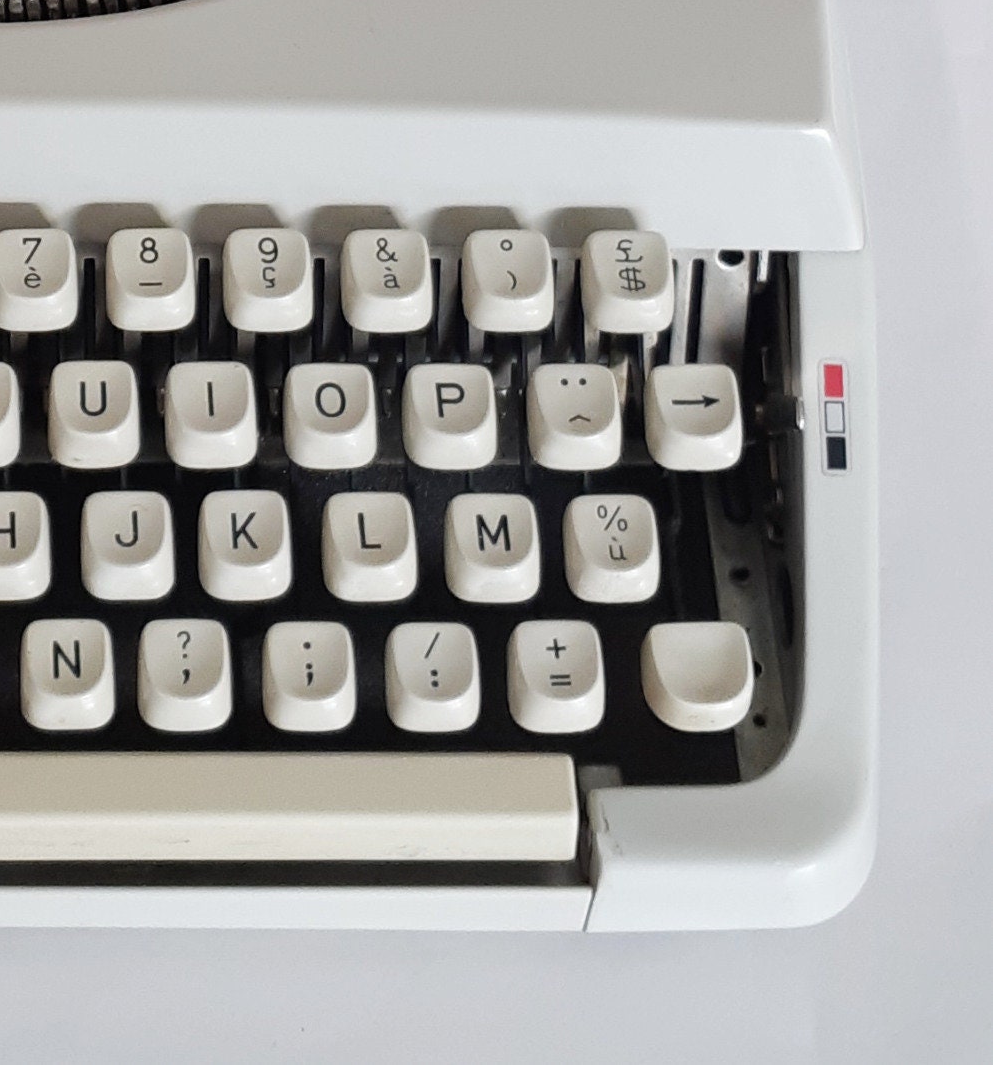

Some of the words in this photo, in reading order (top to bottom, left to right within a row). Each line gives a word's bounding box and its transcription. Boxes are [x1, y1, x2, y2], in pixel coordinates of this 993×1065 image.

[22, 237, 42, 265] 7
[139, 236, 159, 264] 8
[257, 237, 279, 264] 9
[376, 237, 399, 263] &
[23, 266, 42, 289] è
[383, 266, 401, 289] à
[618, 266, 647, 292] $
[79, 380, 108, 417] U
[206, 381, 215, 418] I
[314, 382, 347, 418] O
[435, 382, 466, 419] P
[114, 510, 139, 548] J
[230, 511, 259, 550] K
[357, 512, 382, 550] L
[596, 504, 629, 533] %
[476, 514, 512, 552] M
[608, 536, 629, 562] ù
[176, 630, 191, 659] ?
[424, 632, 440, 659] /
[546, 638, 567, 660] +
[52, 640, 82, 680] N
[549, 674, 572, 687] =
